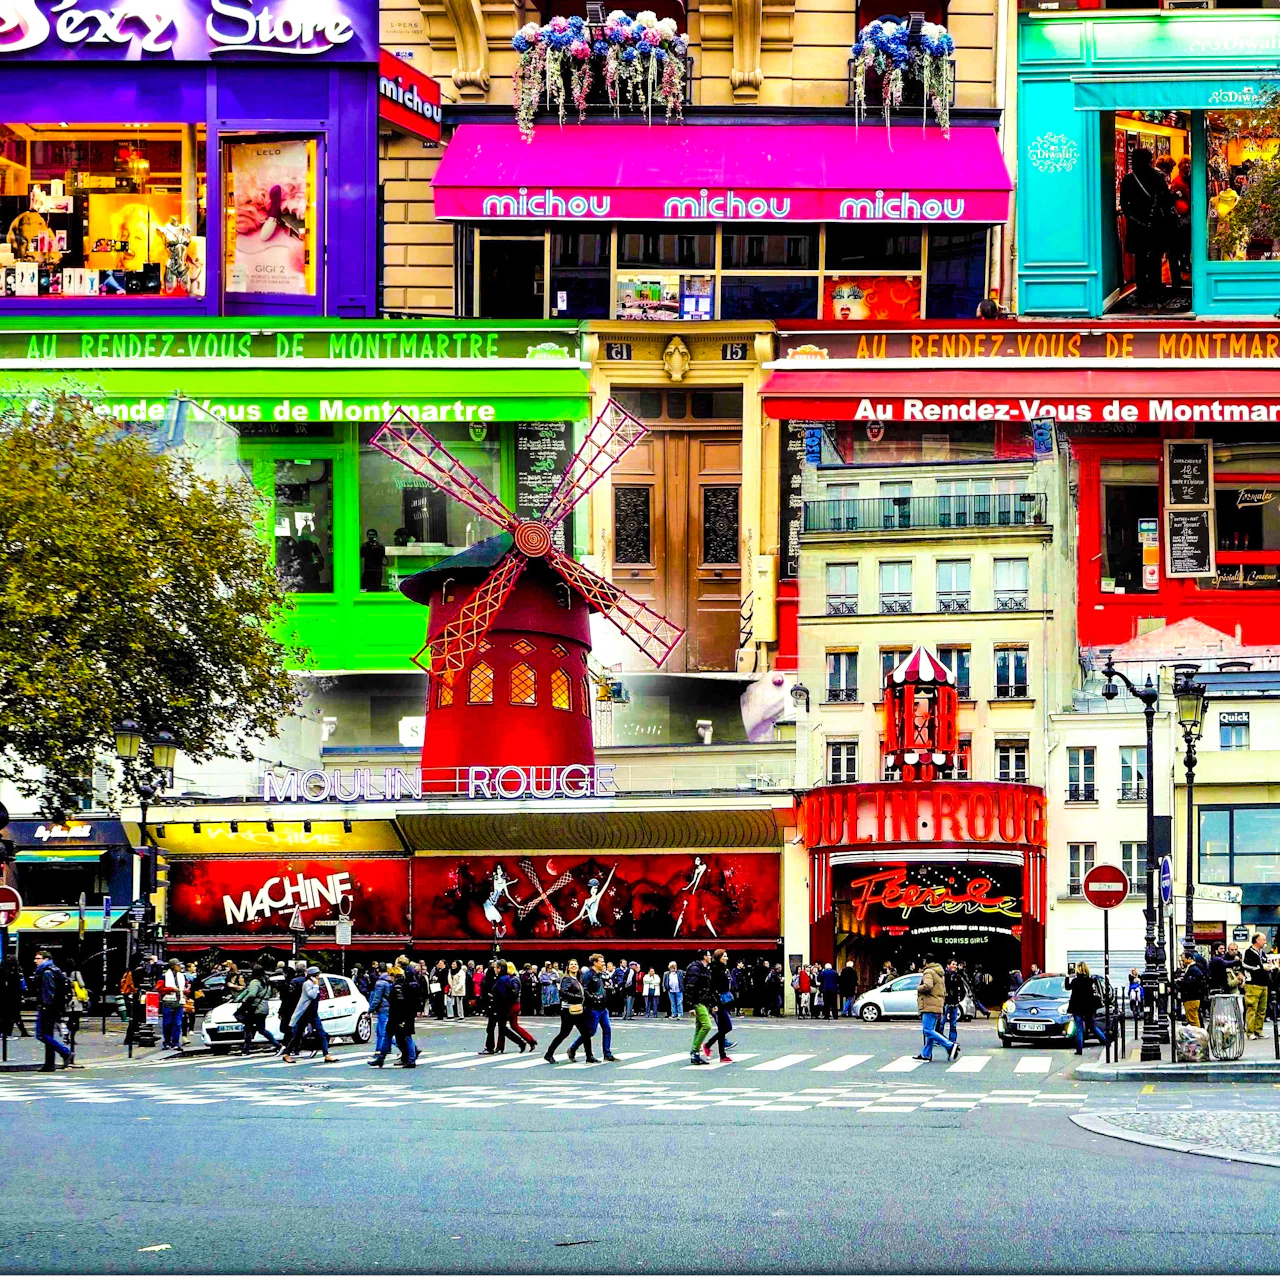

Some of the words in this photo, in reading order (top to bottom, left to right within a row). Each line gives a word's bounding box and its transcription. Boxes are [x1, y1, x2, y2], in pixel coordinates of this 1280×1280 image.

[379, 75, 441, 122] michou
[482, 188, 611, 216] michou
[665, 189, 790, 218] michou
[840, 190, 965, 220] michou
[28, 333, 58, 359] AU
[80, 333, 252, 359] RENDEZ-VOUS
[276, 333, 305, 359] DE
[330, 333, 499, 359] MONTMARTRE
[724, 344, 743, 360] 15
[856, 334, 886, 358] AU
[910, 334, 1083, 358] RENDEZ-VOUS
[1106, 334, 1134, 358] DE
[273, 400, 309, 421] de
[320, 400, 495, 421] Montmartre
[855, 399, 894, 421] Au
[903, 399, 1092, 421] Rendez-Vous
[1103, 399, 1140, 421] de
[1220, 712, 1249, 723] Quick
[263, 768, 423, 802] MOULIN
[469, 764, 617, 801] ROUGE
[804, 790, 918, 847] OULIN
[933, 790, 1047, 848] ROUG
[223, 871, 354, 924] MACHINE
